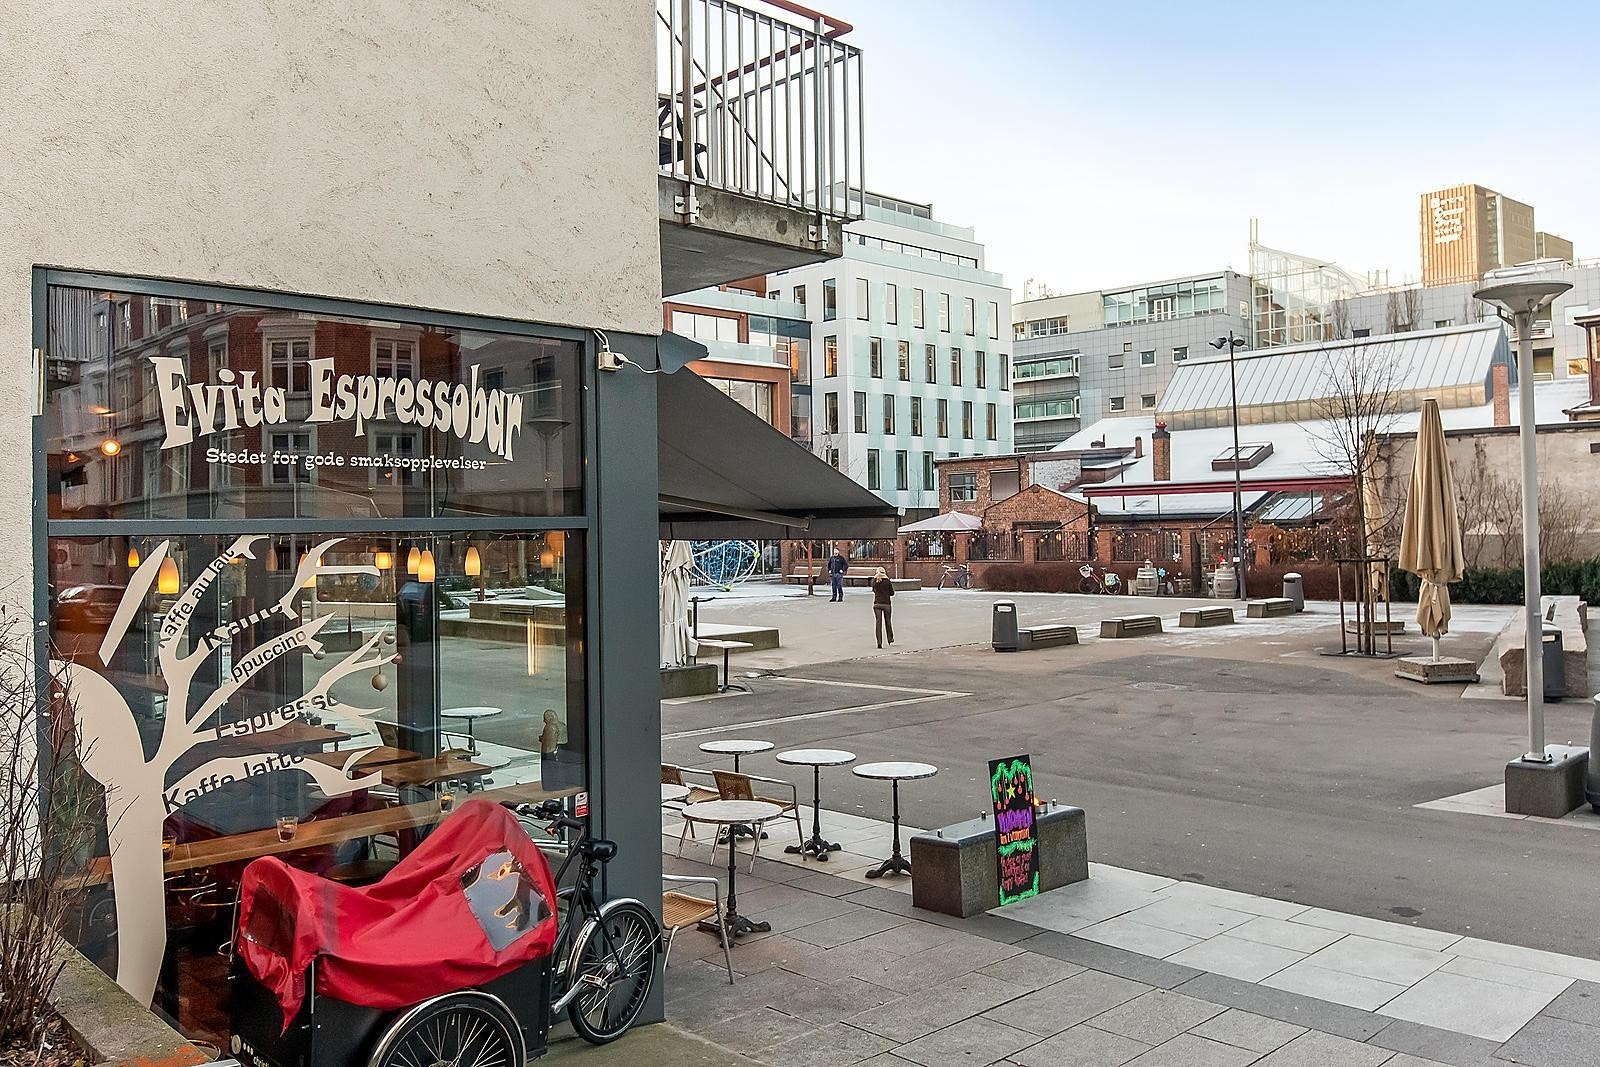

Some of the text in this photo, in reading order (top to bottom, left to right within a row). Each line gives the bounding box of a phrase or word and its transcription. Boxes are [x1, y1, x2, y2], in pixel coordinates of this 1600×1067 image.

[148, 356, 524, 462] Evita Espressobar
[205, 447, 487, 473] Stedet for gode smaksopplevelser
[230, 630, 307, 684] ppuccino
